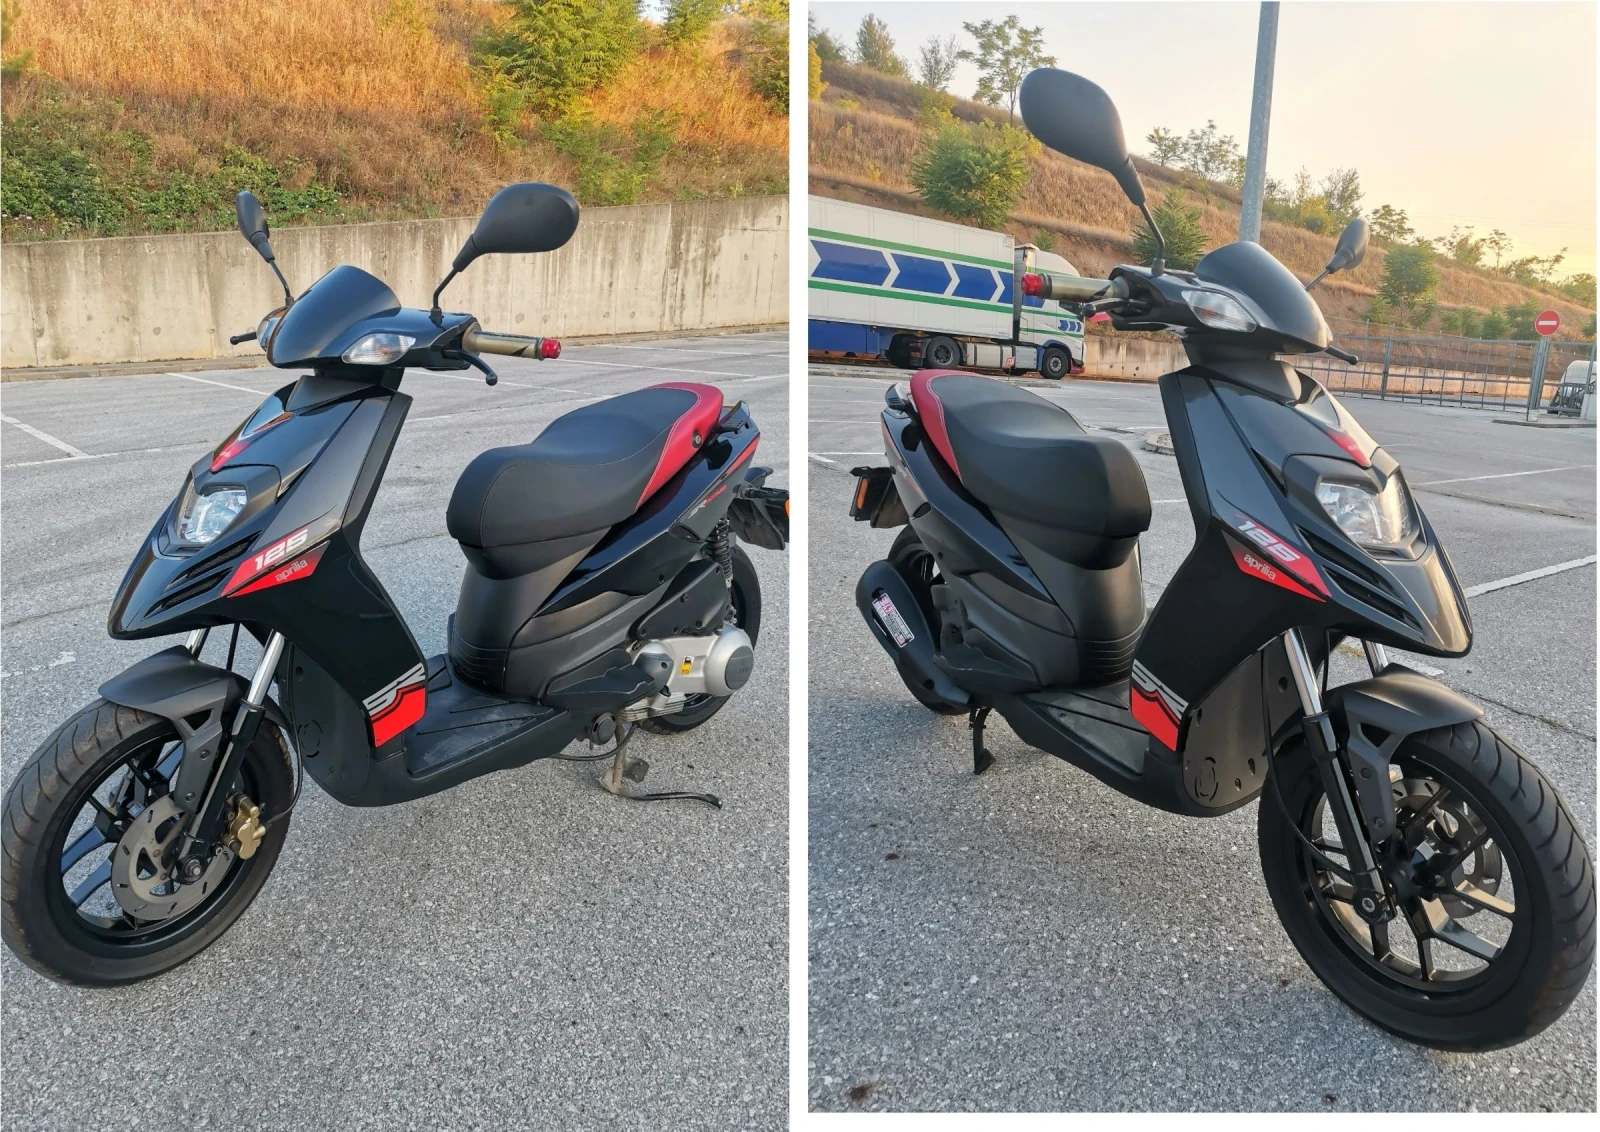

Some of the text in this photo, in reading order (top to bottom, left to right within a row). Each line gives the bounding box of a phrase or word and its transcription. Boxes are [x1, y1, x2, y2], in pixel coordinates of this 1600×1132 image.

[255, 528, 308, 571] 125
[1238, 520, 1301, 562] 125
[275, 559, 308, 582] aprilia
[1243, 554, 1277, 581] aprilia
